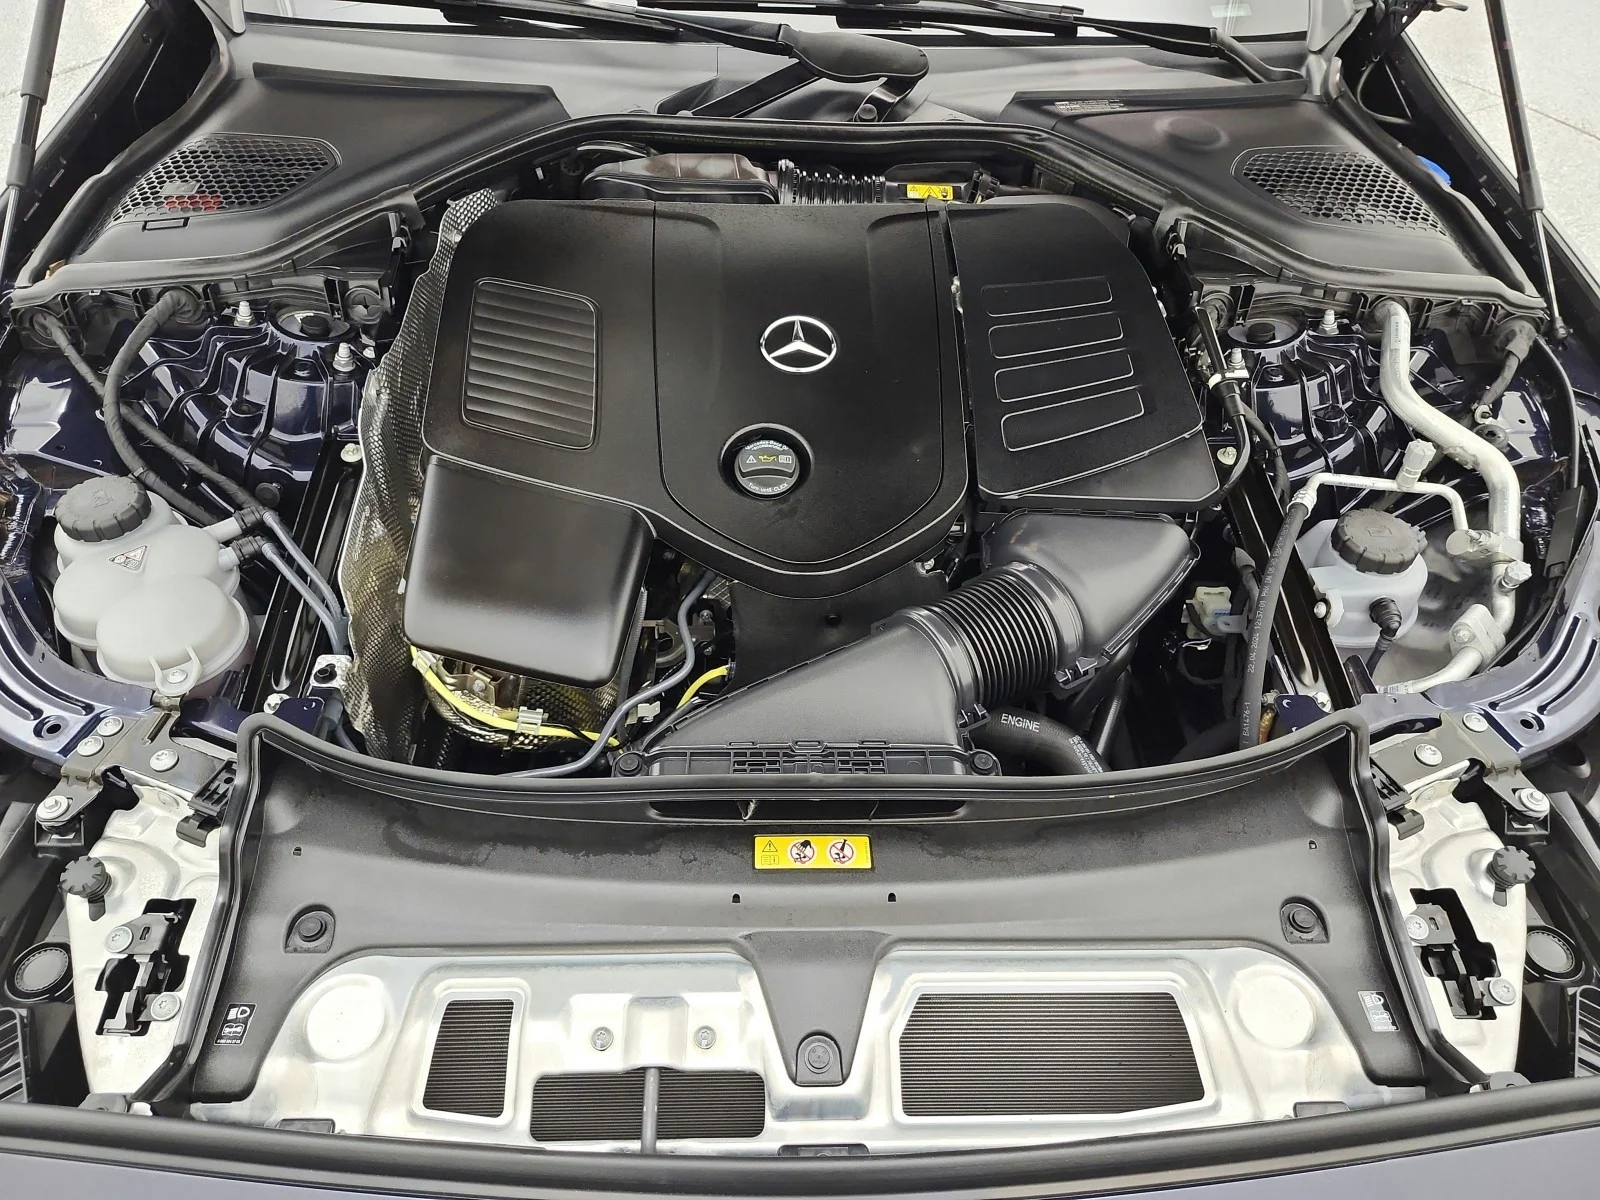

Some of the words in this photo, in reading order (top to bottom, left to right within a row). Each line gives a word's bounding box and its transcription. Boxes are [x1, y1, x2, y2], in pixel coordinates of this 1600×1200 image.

[748, 482, 760, 491] Turn
[773, 482, 789, 492] CLICK
[1000, 713, 1041, 733] ENGINE
